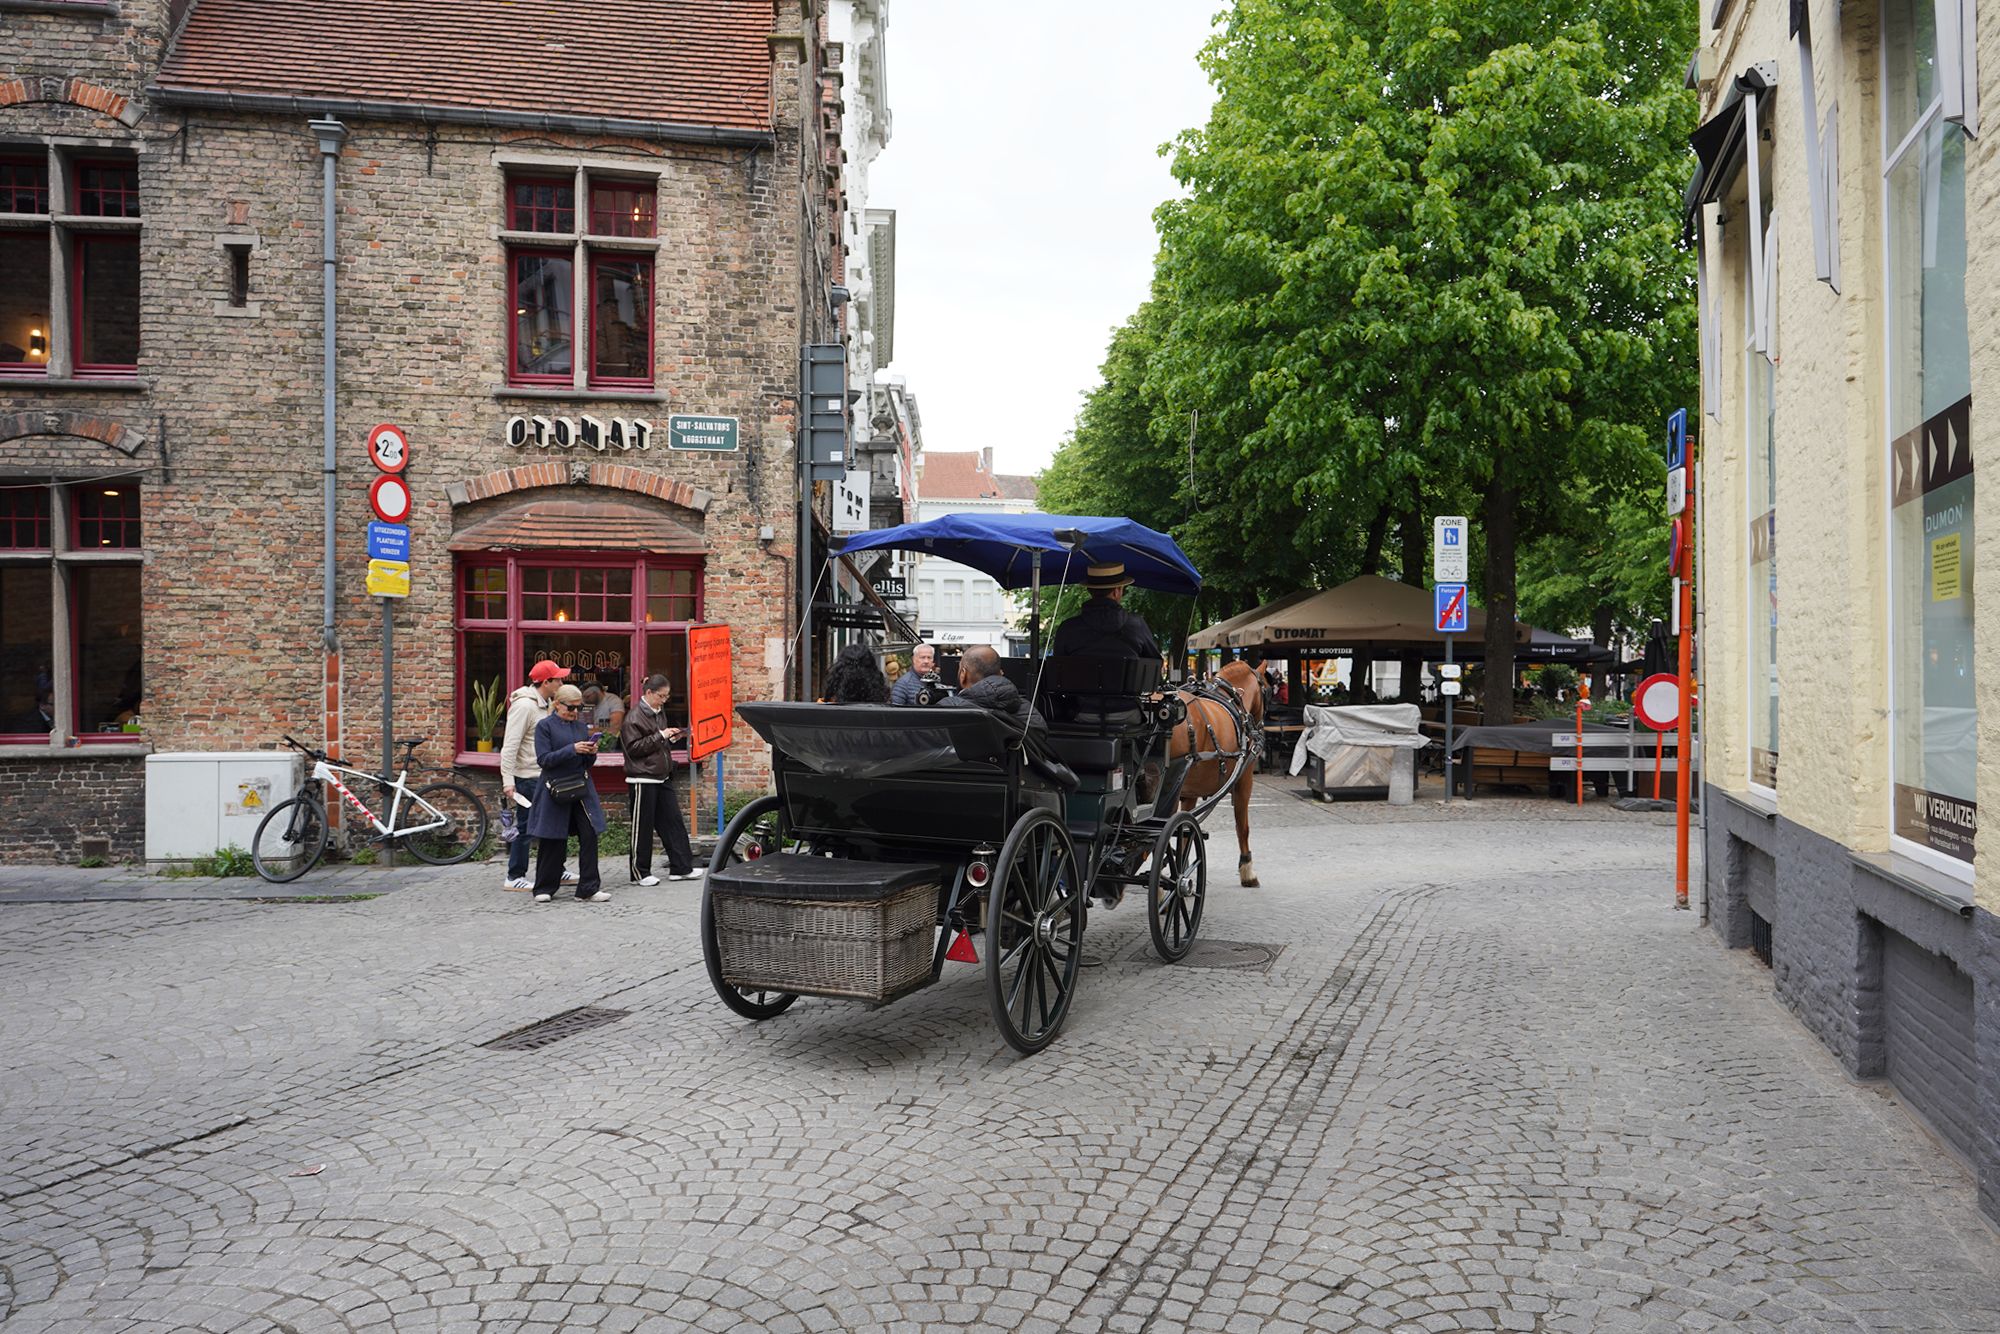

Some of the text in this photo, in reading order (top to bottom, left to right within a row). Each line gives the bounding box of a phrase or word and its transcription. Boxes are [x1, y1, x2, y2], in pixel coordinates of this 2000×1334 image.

[676, 420, 730, 431] SINT-SALVATORS
[506, 414, 653, 451] OTOMAT
[682, 435, 725, 445] KOORSTRAAT
[872, 580, 904, 594] ellis
[1274, 628, 1327, 639] OTOMAT
[1914, 793, 1977, 830] WIJ VERHUIZEN
